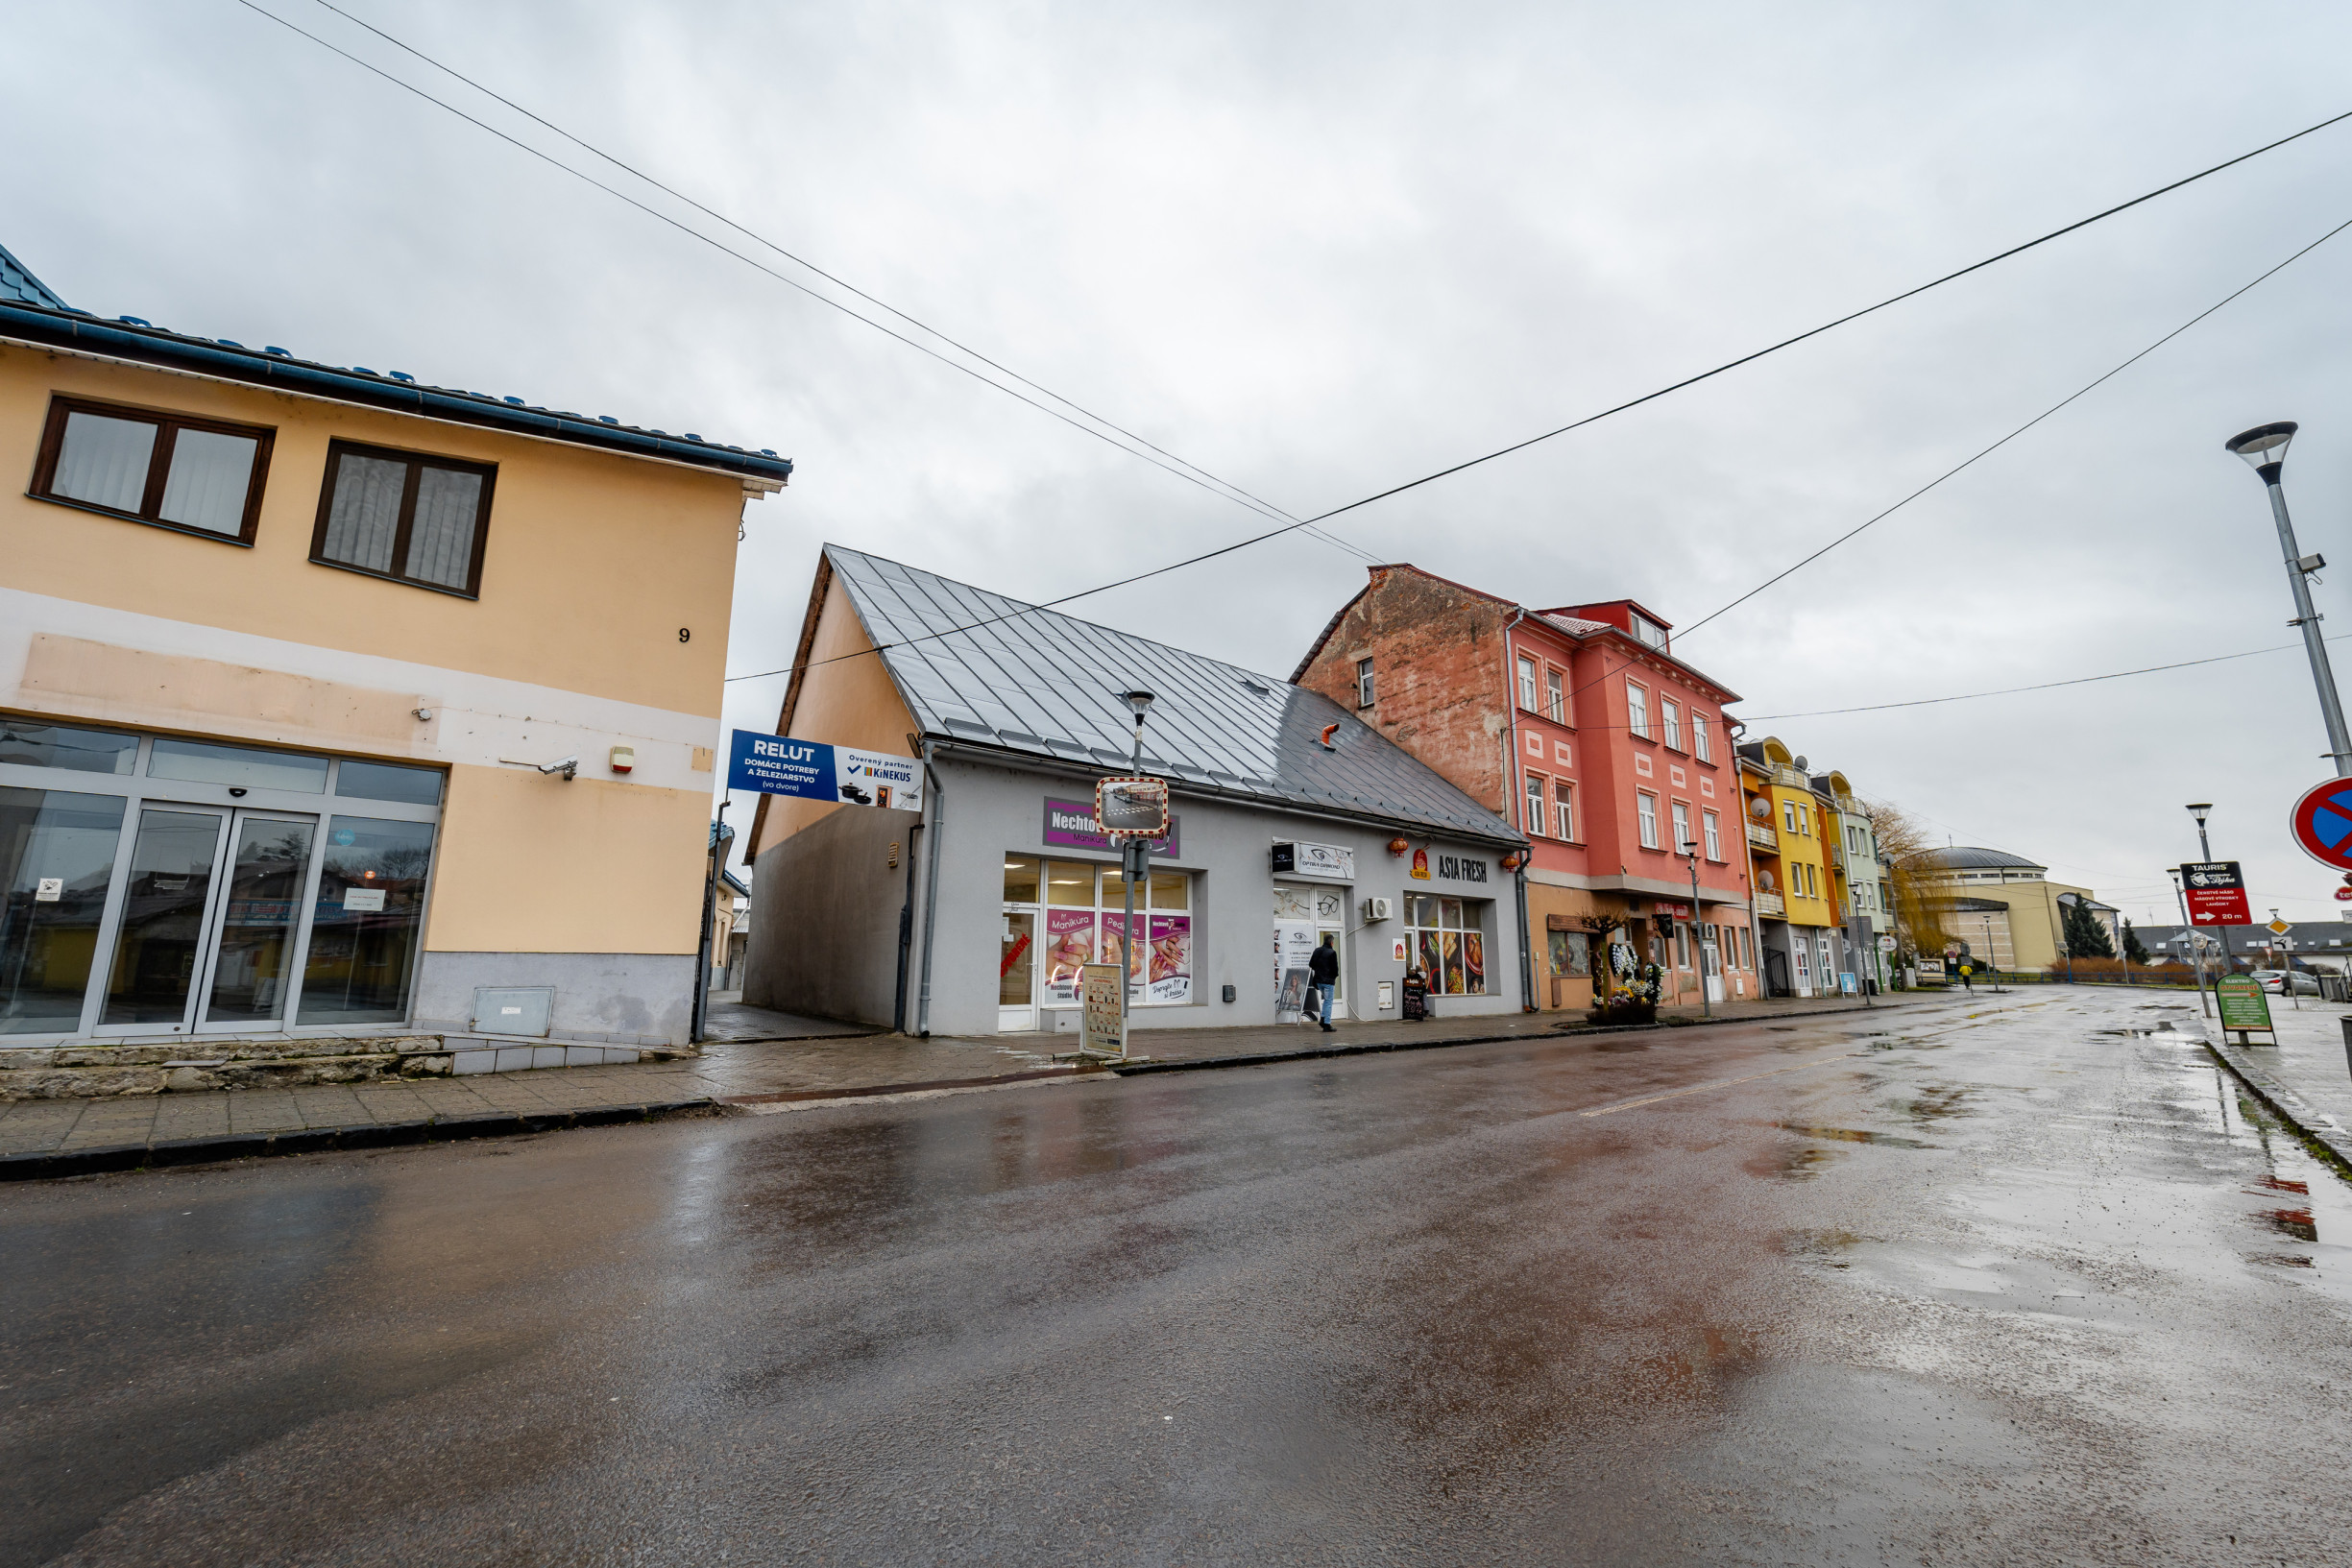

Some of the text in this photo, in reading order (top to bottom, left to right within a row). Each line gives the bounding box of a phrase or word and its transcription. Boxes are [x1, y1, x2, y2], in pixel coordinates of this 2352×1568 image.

[679, 627, 691, 643] 9
[753, 739, 815, 762] RELUT
[744, 758, 820, 775] DOMÁCE POTREBY
[849, 754, 913, 770] Overený partner
[756, 768, 815, 784] ŽELEZIARSTVO
[762, 780, 800, 792] (vo dvore)
[1052, 811, 1101, 833] Nechto
[1073, 833, 1107, 844] Manikúra
[1439, 855, 1488, 883] ASIA FRESH
[1052, 916, 1089, 930] Manikúra
[1107, 917, 1139, 935] Pedira
